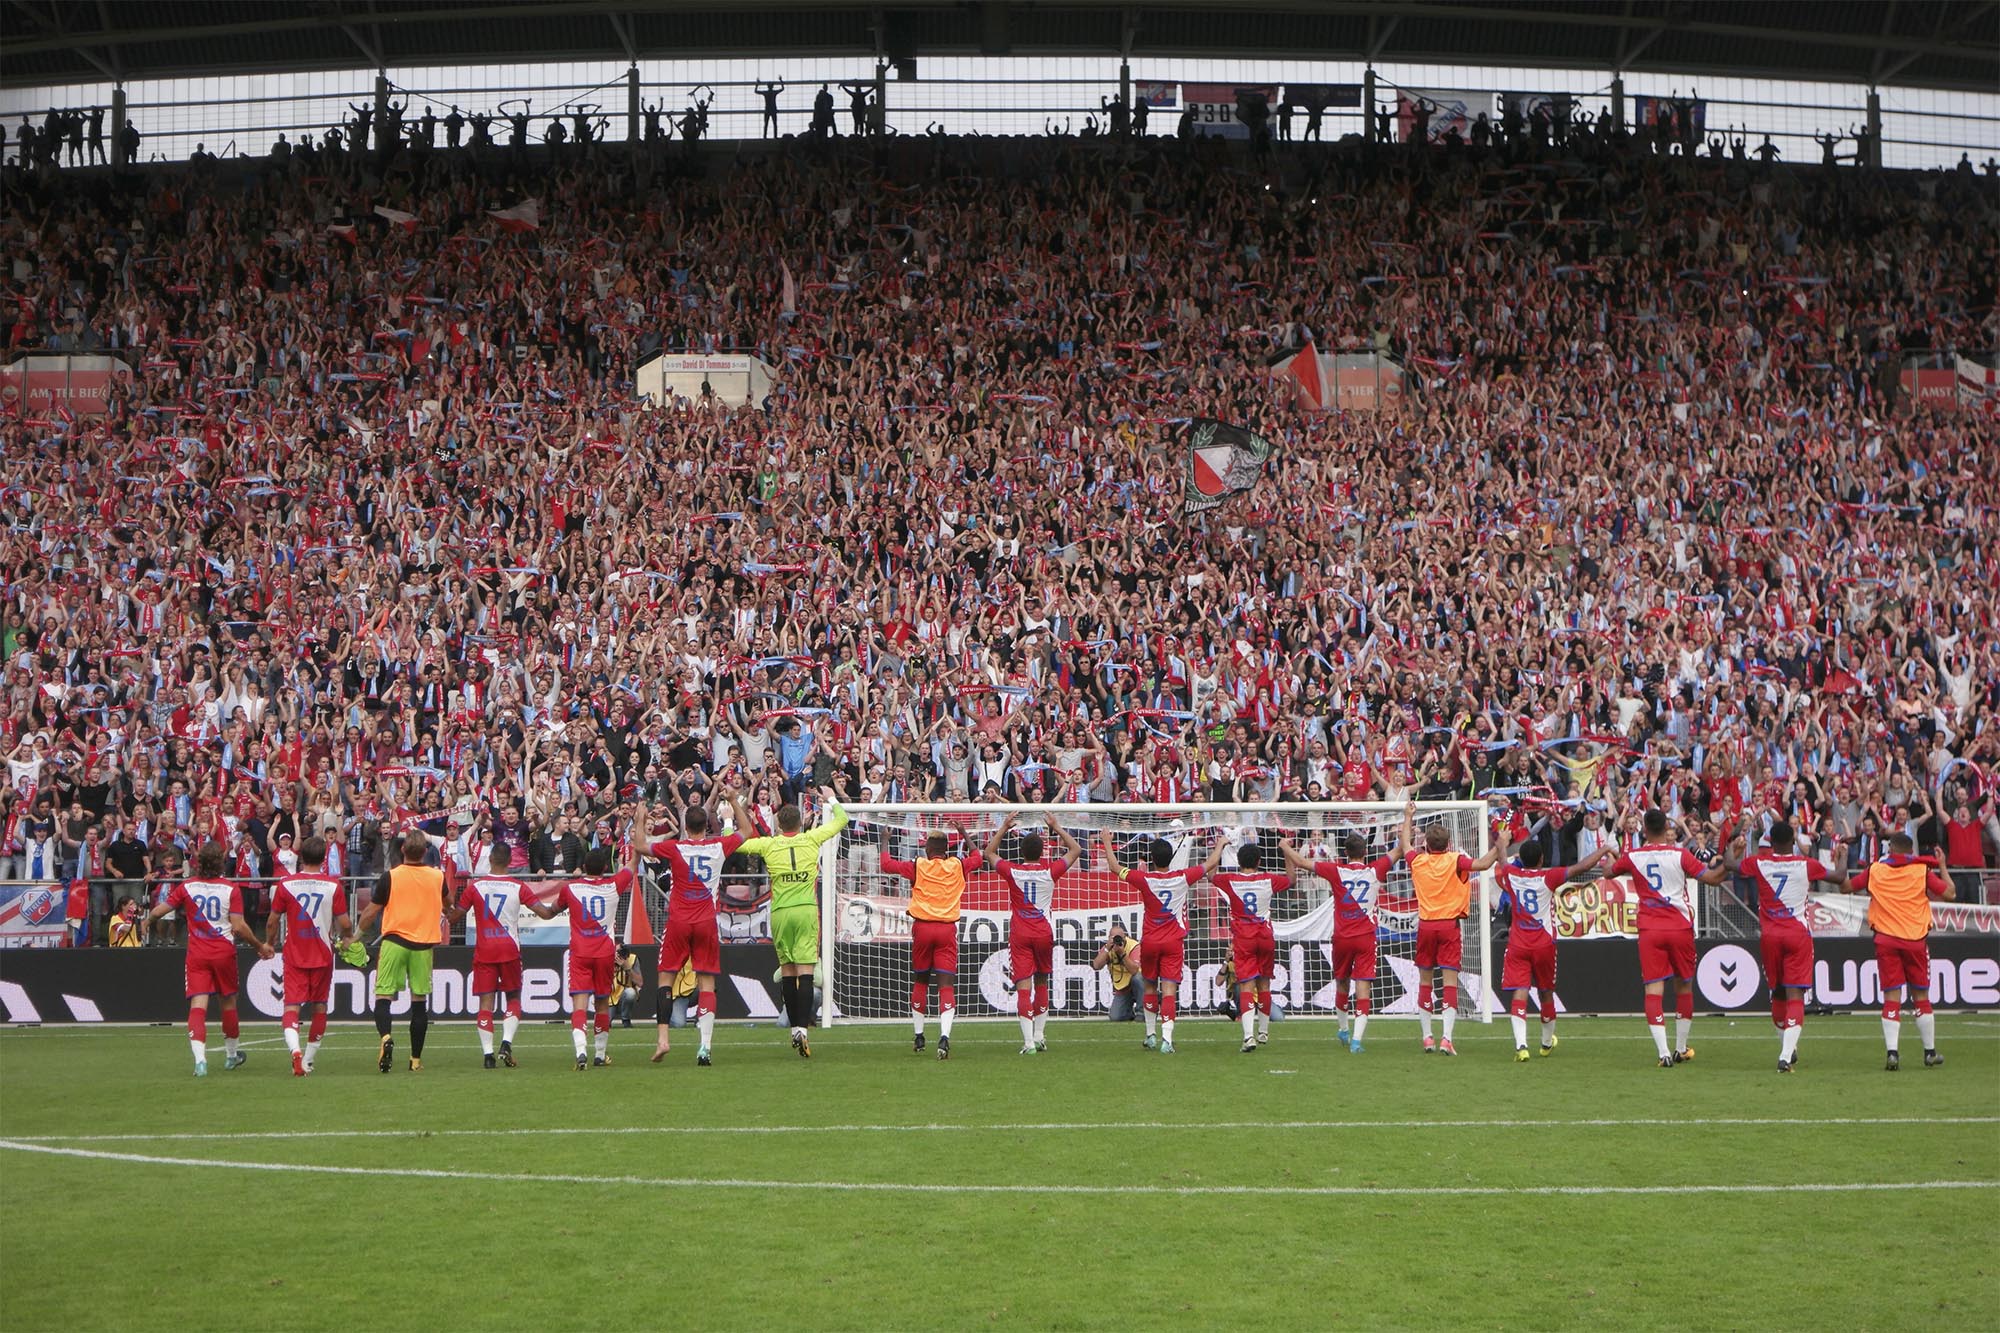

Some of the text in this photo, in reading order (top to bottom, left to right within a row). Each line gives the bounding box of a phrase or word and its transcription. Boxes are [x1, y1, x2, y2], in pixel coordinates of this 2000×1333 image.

[30, 388, 107, 398] AMTEL BIE
[1921, 386, 1953, 398] AMST
[689, 856, 712, 883] 15
[790, 847, 796, 871] 1
[781, 871, 809, 883] TELE2
[1646, 864, 1662, 891] 5
[1772, 873, 1788, 900] 7
[1024, 882, 1036, 904] 11
[1158, 890, 1173, 912] 2
[1243, 892, 1257, 915] 8
[1342, 880, 1370, 903] 22
[1516, 889, 1538, 914] 18
[192, 894, 221, 922] 20
[296, 893, 324, 920] 27
[483, 893, 507, 921] 17
[581, 895, 606, 922] 10
[884, 908, 913, 935] DA
[1557, 903, 1639, 937] STRIE
